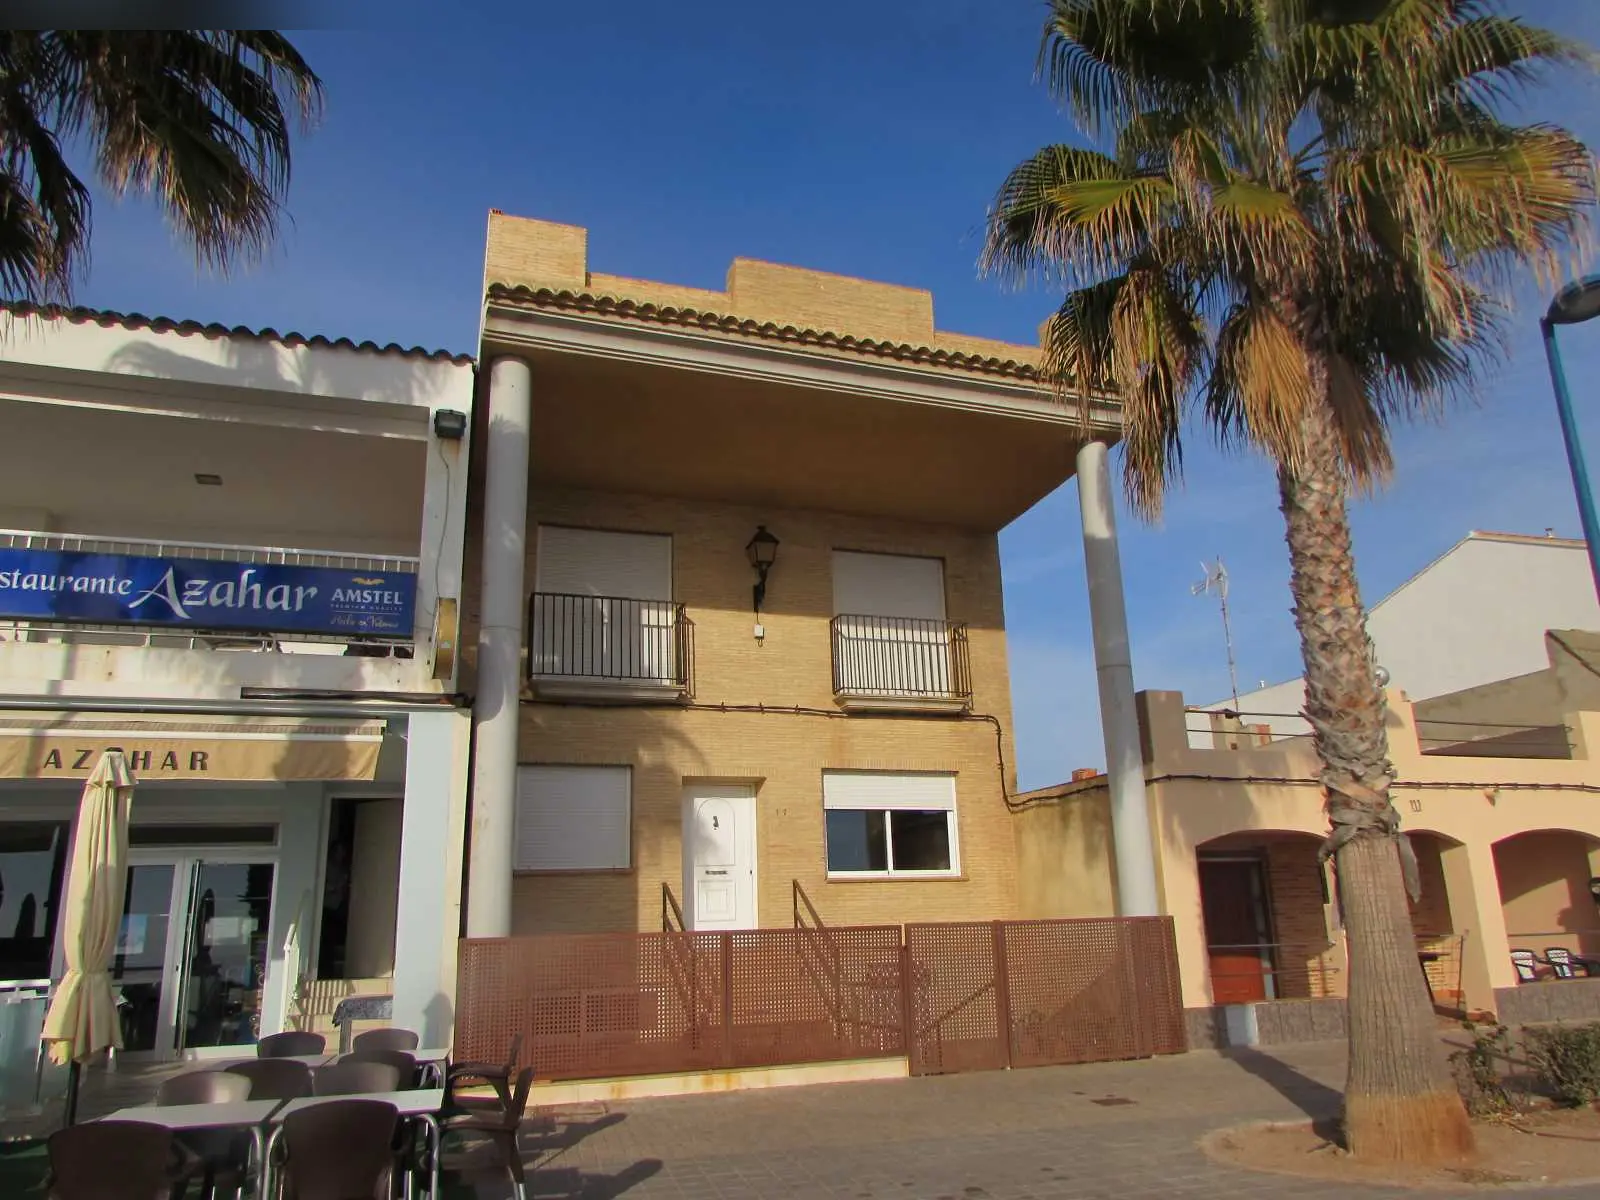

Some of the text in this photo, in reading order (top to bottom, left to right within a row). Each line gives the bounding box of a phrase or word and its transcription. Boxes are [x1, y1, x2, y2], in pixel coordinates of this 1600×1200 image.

[128, 565, 318, 620] Azahar
[331, 587, 403, 605] AMSTEL
[43, 748, 209, 771] AZHAR
